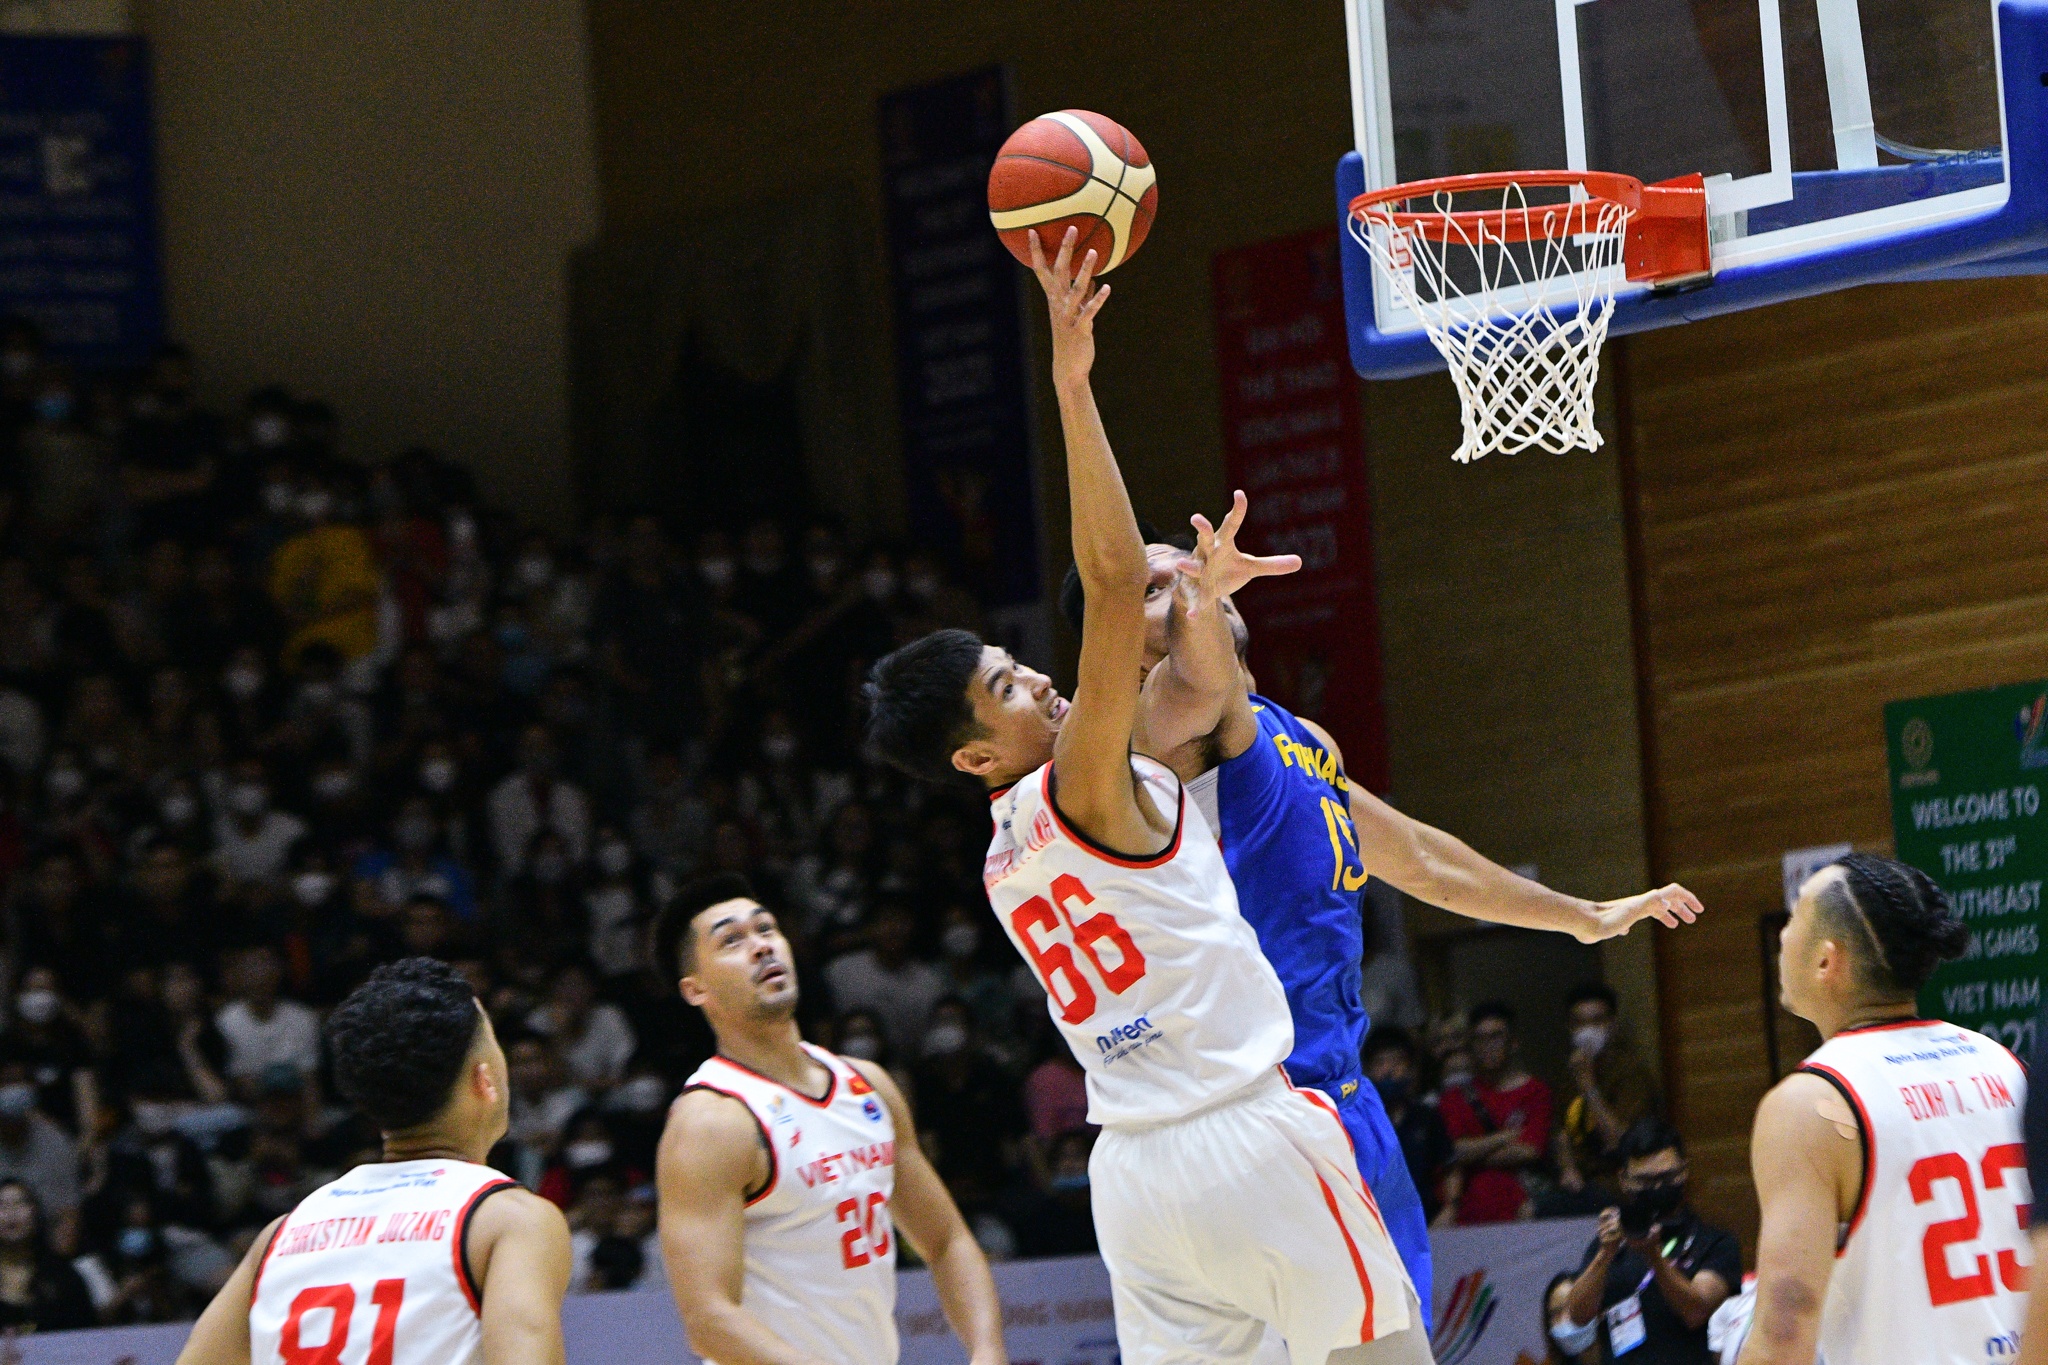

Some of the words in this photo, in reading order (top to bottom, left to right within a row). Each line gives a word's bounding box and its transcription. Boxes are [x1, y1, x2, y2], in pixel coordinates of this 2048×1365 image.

[1911, 789, 2010, 830] WELCOME
[2012, 785, 2040, 817] TO
[1320, 796, 1368, 891] 15
[1940, 841, 1981, 875] THE
[1010, 873, 1146, 1026] 66
[1942, 981, 1988, 1013] VIET
[377, 1209, 451, 1244] JUZANG
[836, 1191, 890, 1270] 20
